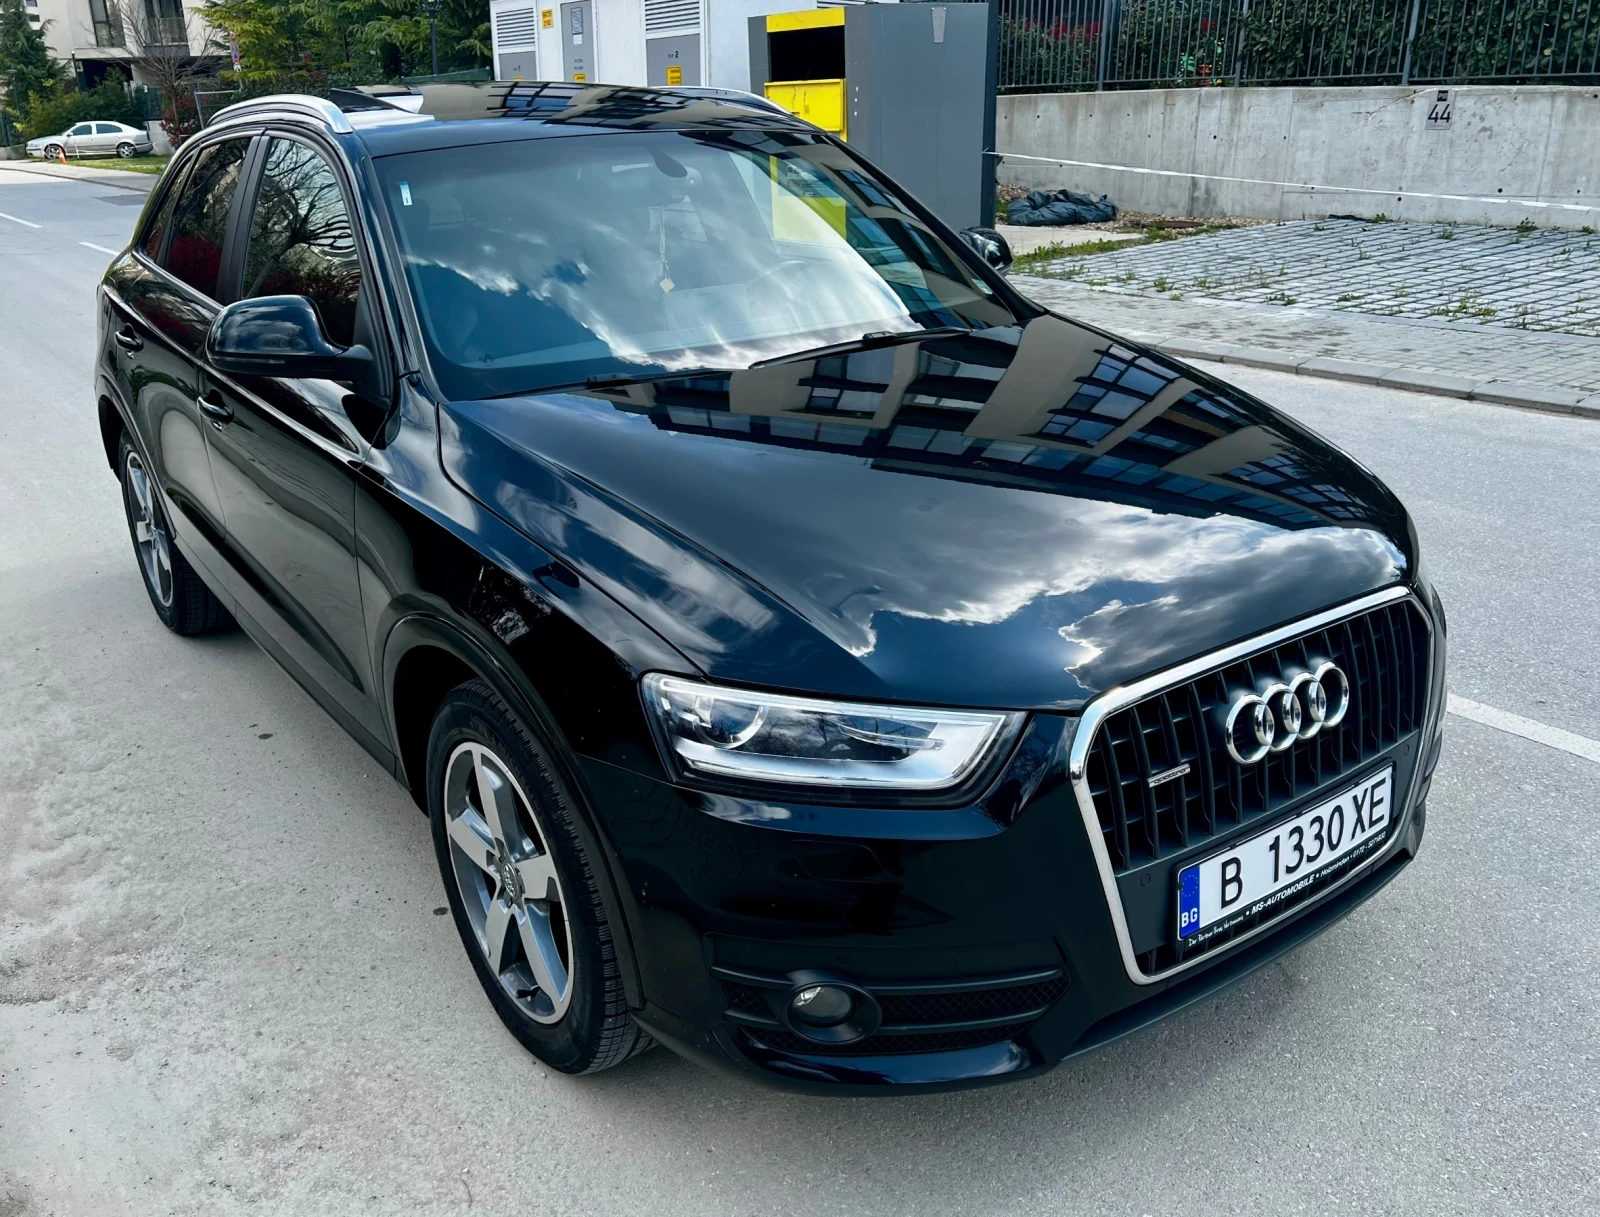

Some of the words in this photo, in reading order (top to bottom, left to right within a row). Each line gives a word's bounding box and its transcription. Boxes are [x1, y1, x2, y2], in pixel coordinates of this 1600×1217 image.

[1428, 104, 1451, 123] 44
[1221, 857, 1243, 909] B
[1269, 805, 1345, 883] 1330
[1351, 777, 1387, 840] XE
[1251, 873, 1315, 915] MS-AUTOMOBILE
[1181, 907, 1198, 928] BG
